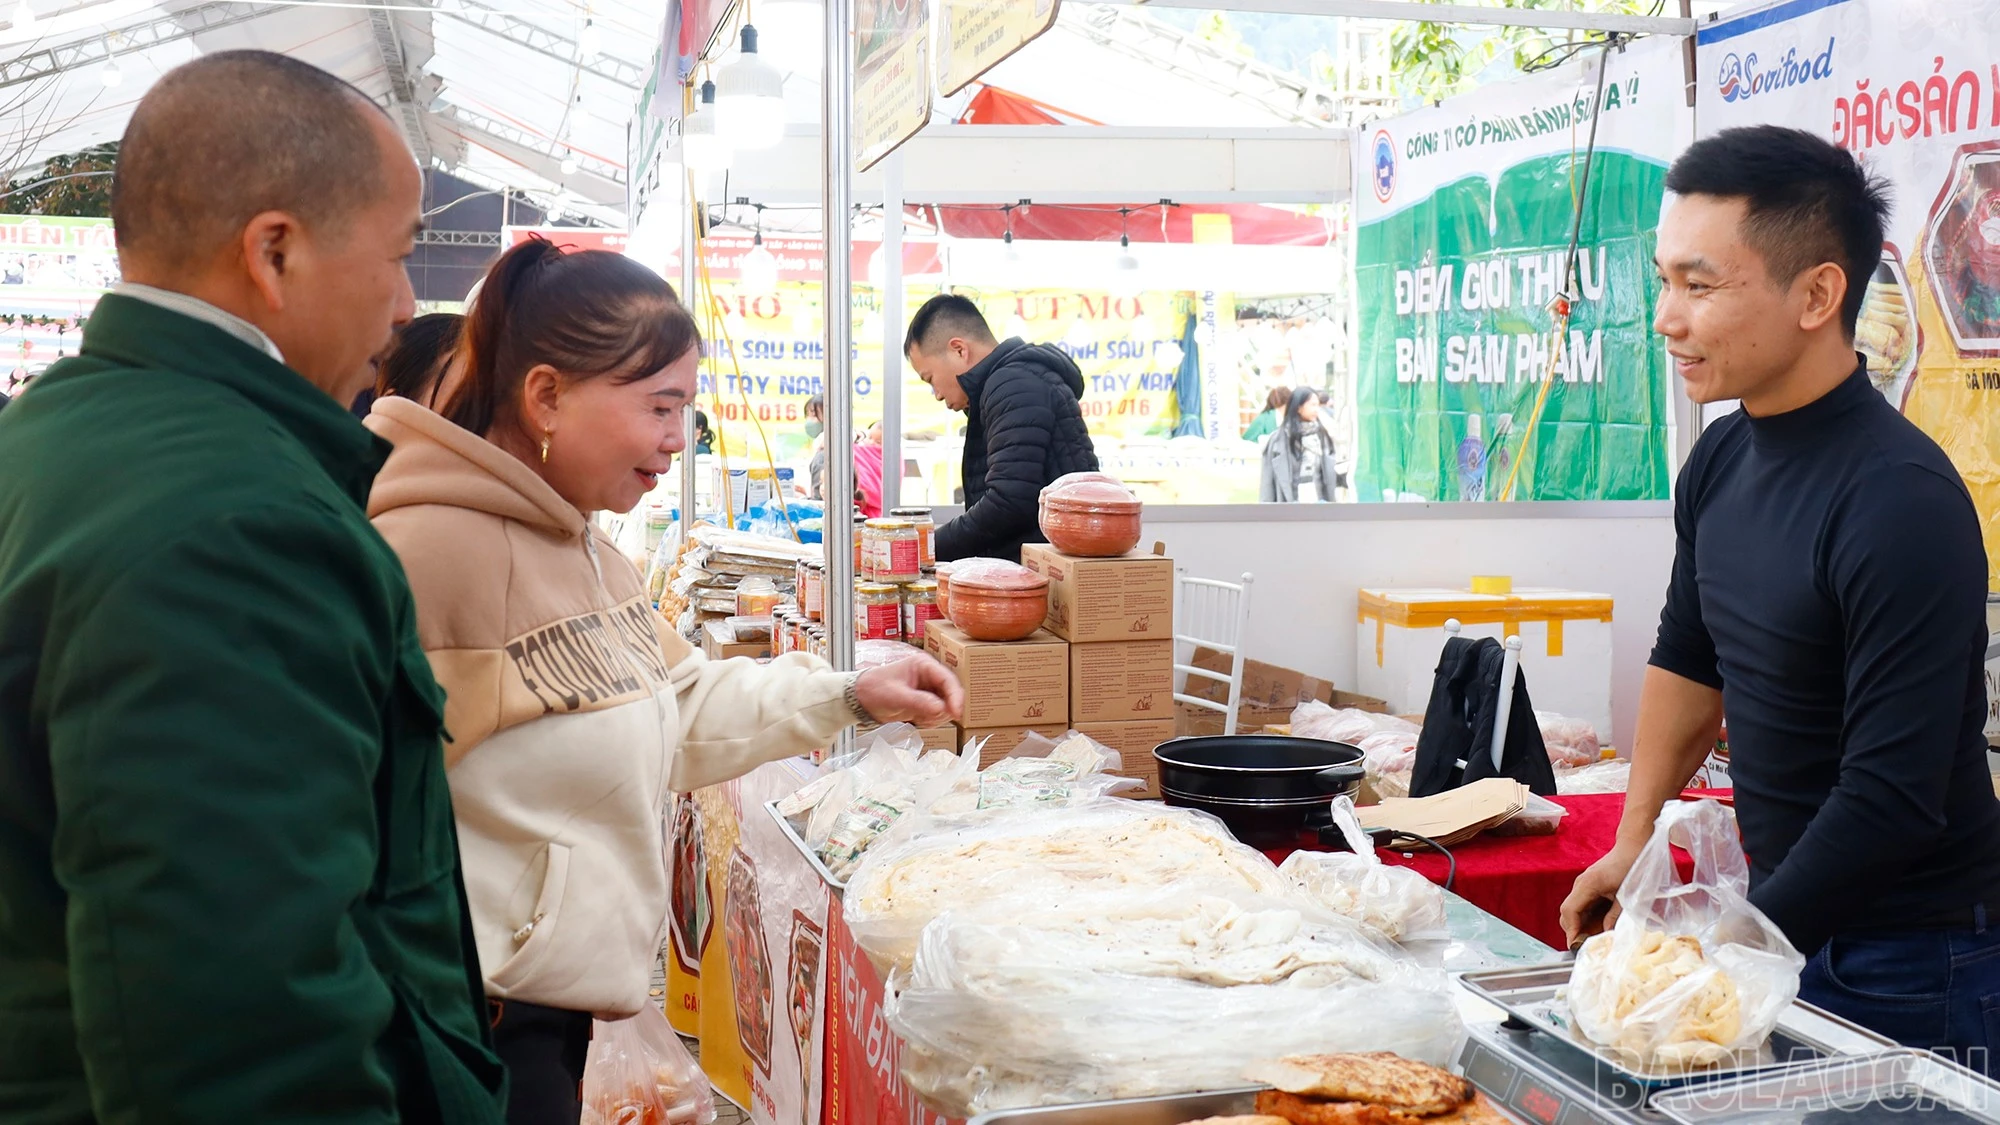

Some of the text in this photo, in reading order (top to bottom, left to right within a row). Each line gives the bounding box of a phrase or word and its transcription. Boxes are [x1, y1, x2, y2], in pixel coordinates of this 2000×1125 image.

[1740, 37, 1835, 99] Sovifood
[1407, 131, 1438, 160] CÔNG
[1455, 115, 1477, 148] CỔ
[1519, 102, 1571, 137] BÁNH
[1460, 247, 1511, 310] GIỚI
[1396, 326, 1437, 382] BÁN
[1445, 321, 1509, 382] SẢN
